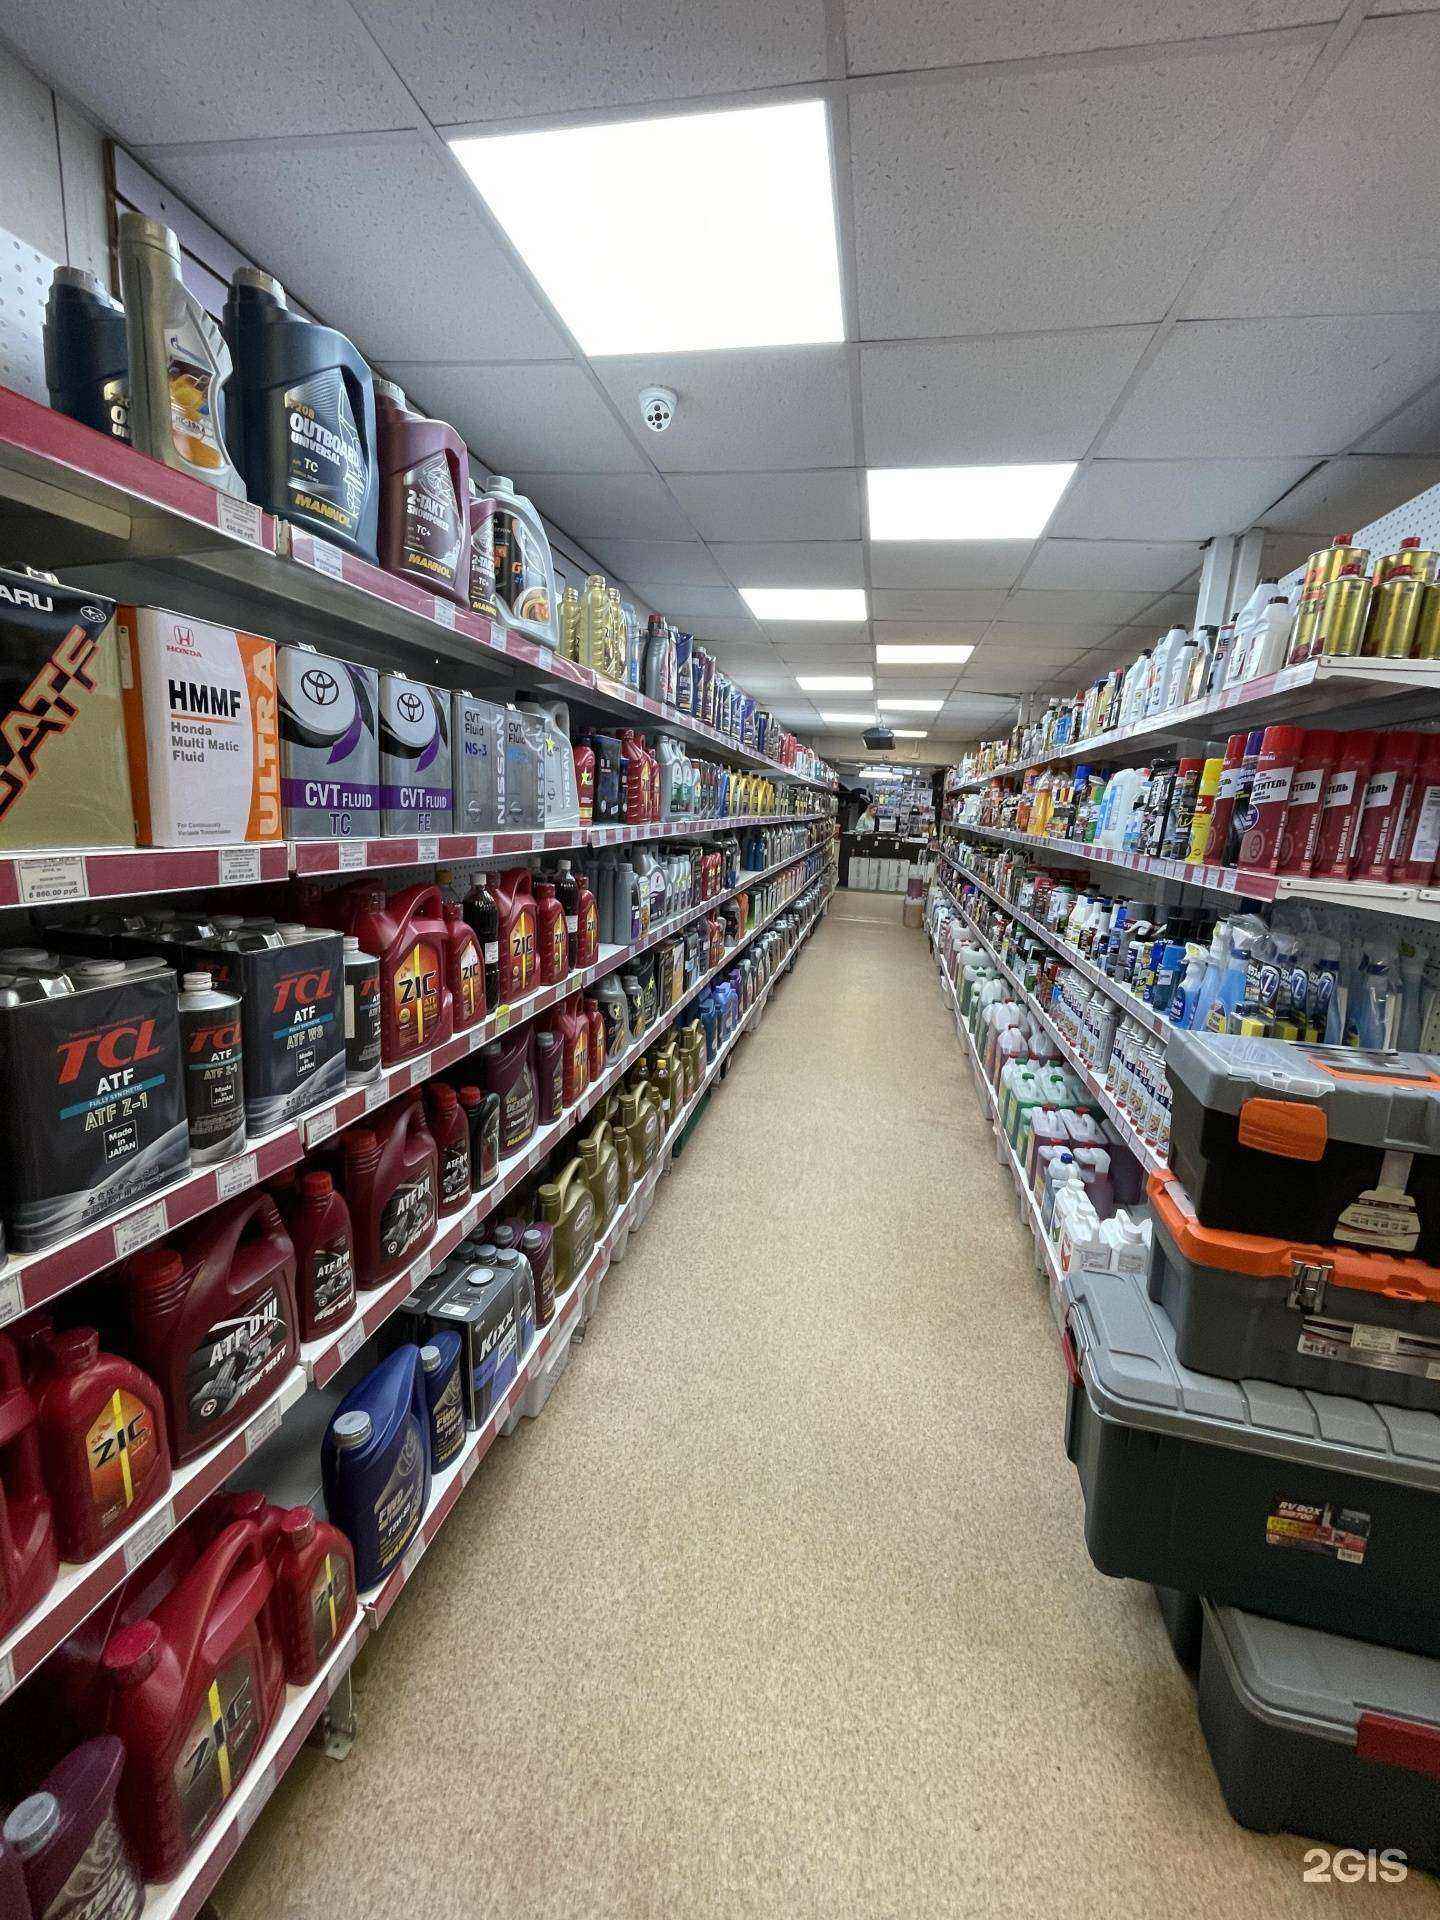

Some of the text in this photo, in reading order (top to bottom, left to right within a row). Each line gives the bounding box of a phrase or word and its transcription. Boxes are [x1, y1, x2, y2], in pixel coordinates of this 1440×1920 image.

[290, 412, 360, 466] OUTBOARD
[291, 430, 341, 467] UNIVERSAL
[304, 458, 319, 473] TC
[408, 553, 451, 579] MANNOL
[0, 586, 54, 612] ARU
[166, 645, 203, 658] HONDA
[167, 678, 242, 718] HMMF
[464, 710, 480, 722] CVT
[171, 721, 213, 736] Honda
[464, 723, 484, 736] Fluid
[171, 736, 241, 753] Multi Matic
[252, 643, 281, 836] ULTRA
[465, 742, 488, 757] NS-3
[172, 749, 206, 764] Fluid
[496, 712, 506, 825] NISSAN
[304, 782, 372, 808] CVT FLUID
[1253, 779, 1288, 792] СТИТЕЛЬ
[399, 786, 447, 809] CVT FLUID
[329, 812, 351, 836] TC
[417, 812, 431, 834] FE
[512, 933, 533, 958] ZIC
[554, 931, 566, 945] ZIC
[462, 961, 479, 981] ZIC
[272, 969, 334, 1014] TCL
[360, 976, 380, 997] TC
[398, 969, 437, 1005] ZIC
[293, 1005, 316, 1025] ATF
[286, 1031, 305, 1051] ATF
[56, 1019, 162, 1085] TCL
[210, 1048, 233, 1063] ATF
[97, 1067, 135, 1096] ATF
[203, 1068, 224, 1081] ATF
[213, 1094, 234, 1105] JAPAN
[84, 1091, 149, 1132] ATF Z-1
[108, 1127, 133, 1142] Made
[117, 1138, 126, 1147] in
[107, 1141, 136, 1159] JAPAN
[316, 1260, 336, 1279] ATF
[208, 1323, 247, 1369] ATF
[92, 1410, 147, 1470] ZIC
[1279, 1501, 1298, 1511] RV
[1297, 1504, 1323, 1516] BOX
[183, 1675, 252, 1795] ZIC
